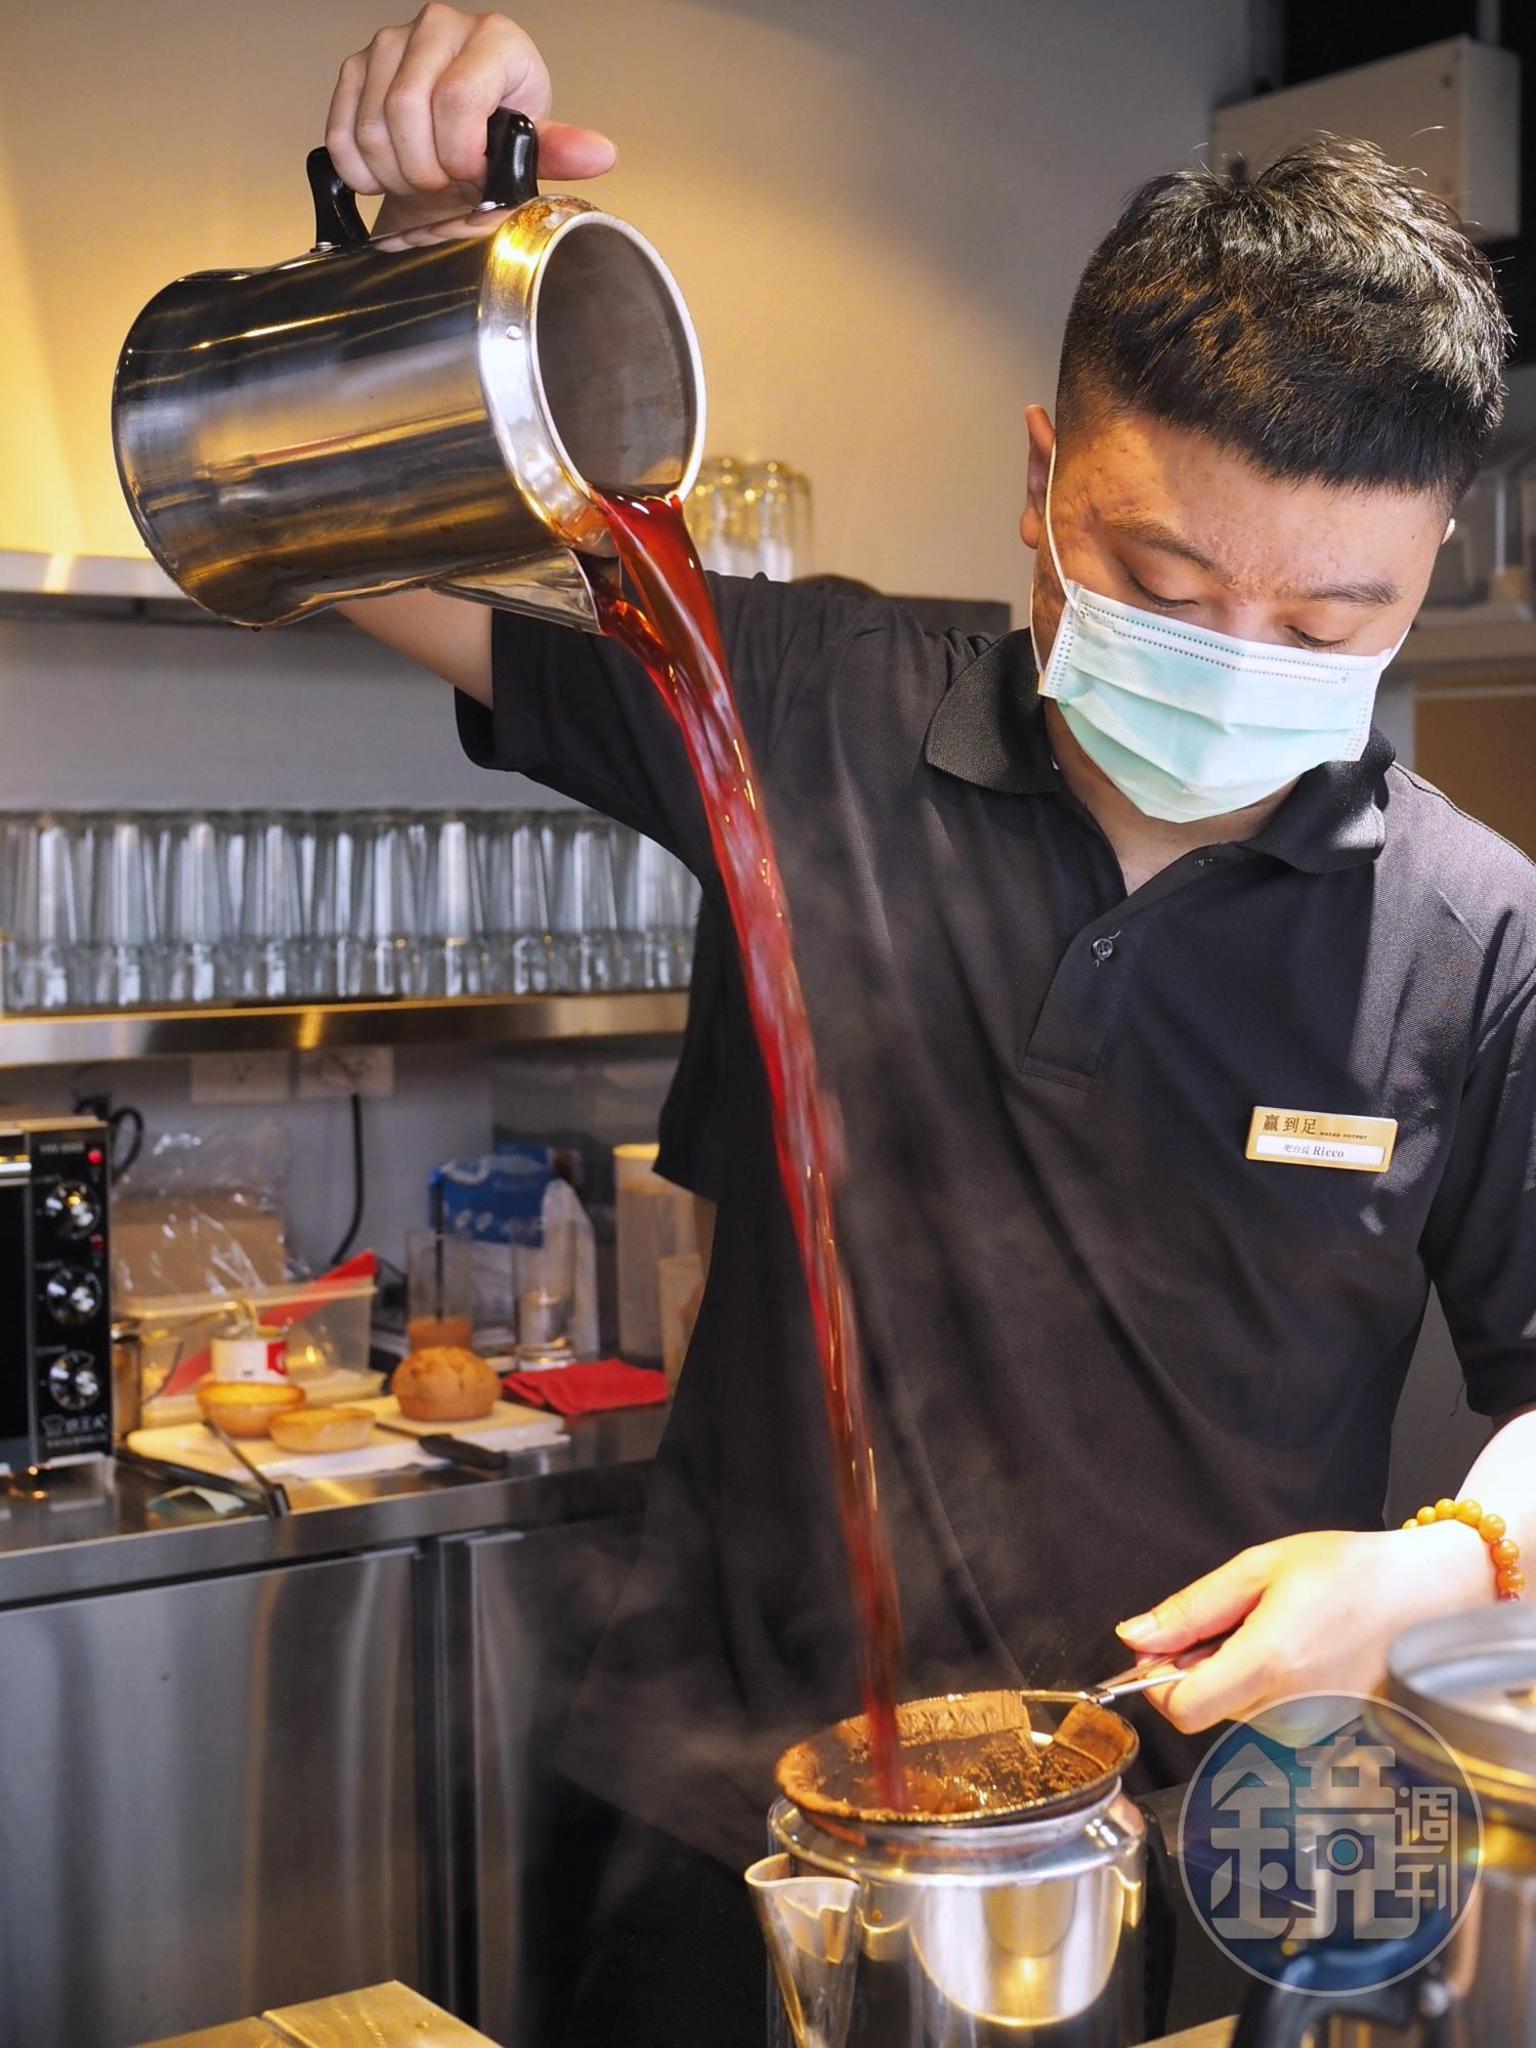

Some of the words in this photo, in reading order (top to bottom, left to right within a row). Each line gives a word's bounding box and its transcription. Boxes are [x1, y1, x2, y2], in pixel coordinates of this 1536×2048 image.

[1263, 1114, 1317, 1135] 贏到足
[1313, 1145, 1345, 1158] Ricco
